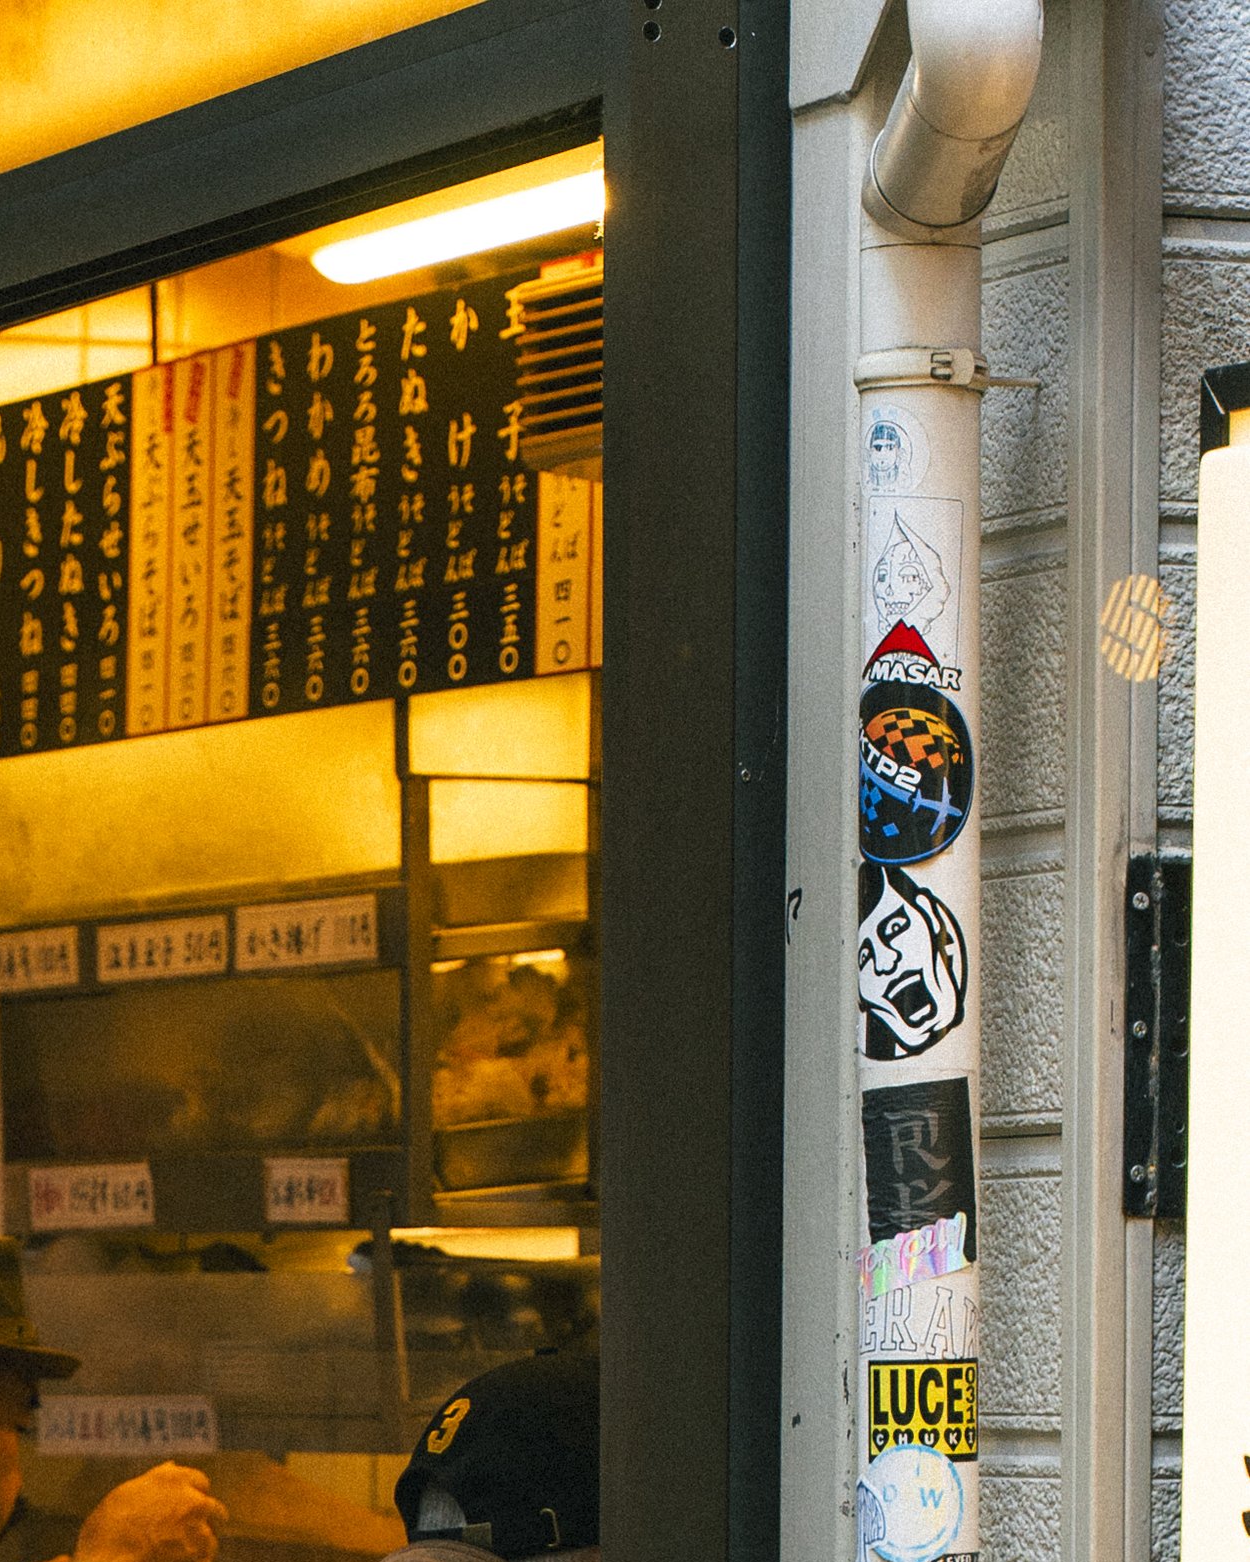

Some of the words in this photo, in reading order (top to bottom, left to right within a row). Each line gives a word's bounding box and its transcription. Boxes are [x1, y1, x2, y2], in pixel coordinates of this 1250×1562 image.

[869, 661, 961, 691] MASAR
[872, 1367, 964, 1426] LUCE
[964, 1366, 976, 1424] 031
[875, 1432, 974, 1447] CHUKI
